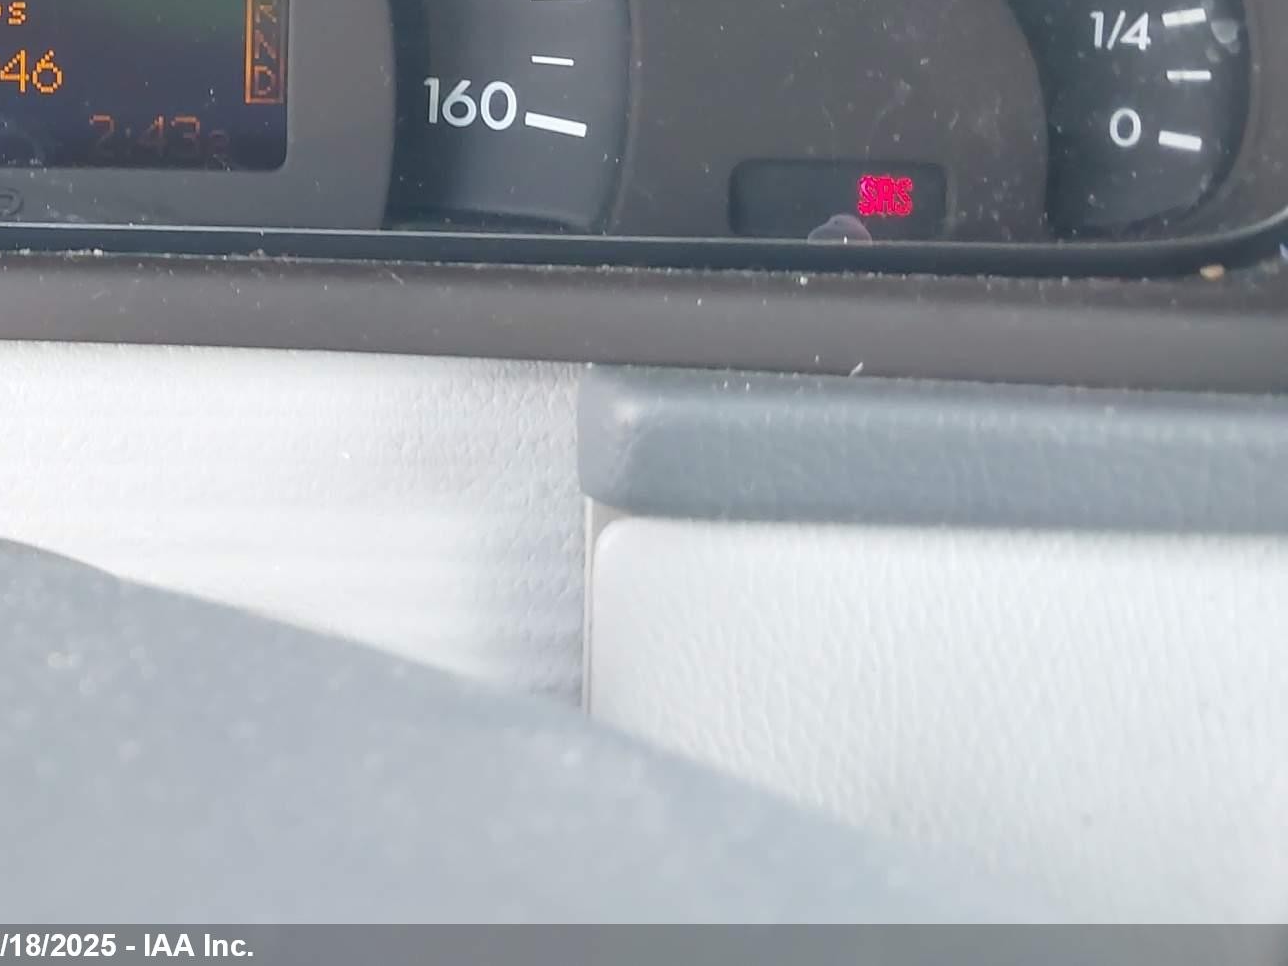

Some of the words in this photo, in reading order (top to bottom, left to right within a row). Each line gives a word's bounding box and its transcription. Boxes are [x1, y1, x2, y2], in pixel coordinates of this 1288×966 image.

[1090, 10, 1151, 50] 1/4
[424, 77, 517, 130] 160
[1111, 110, 1142, 146] 0
